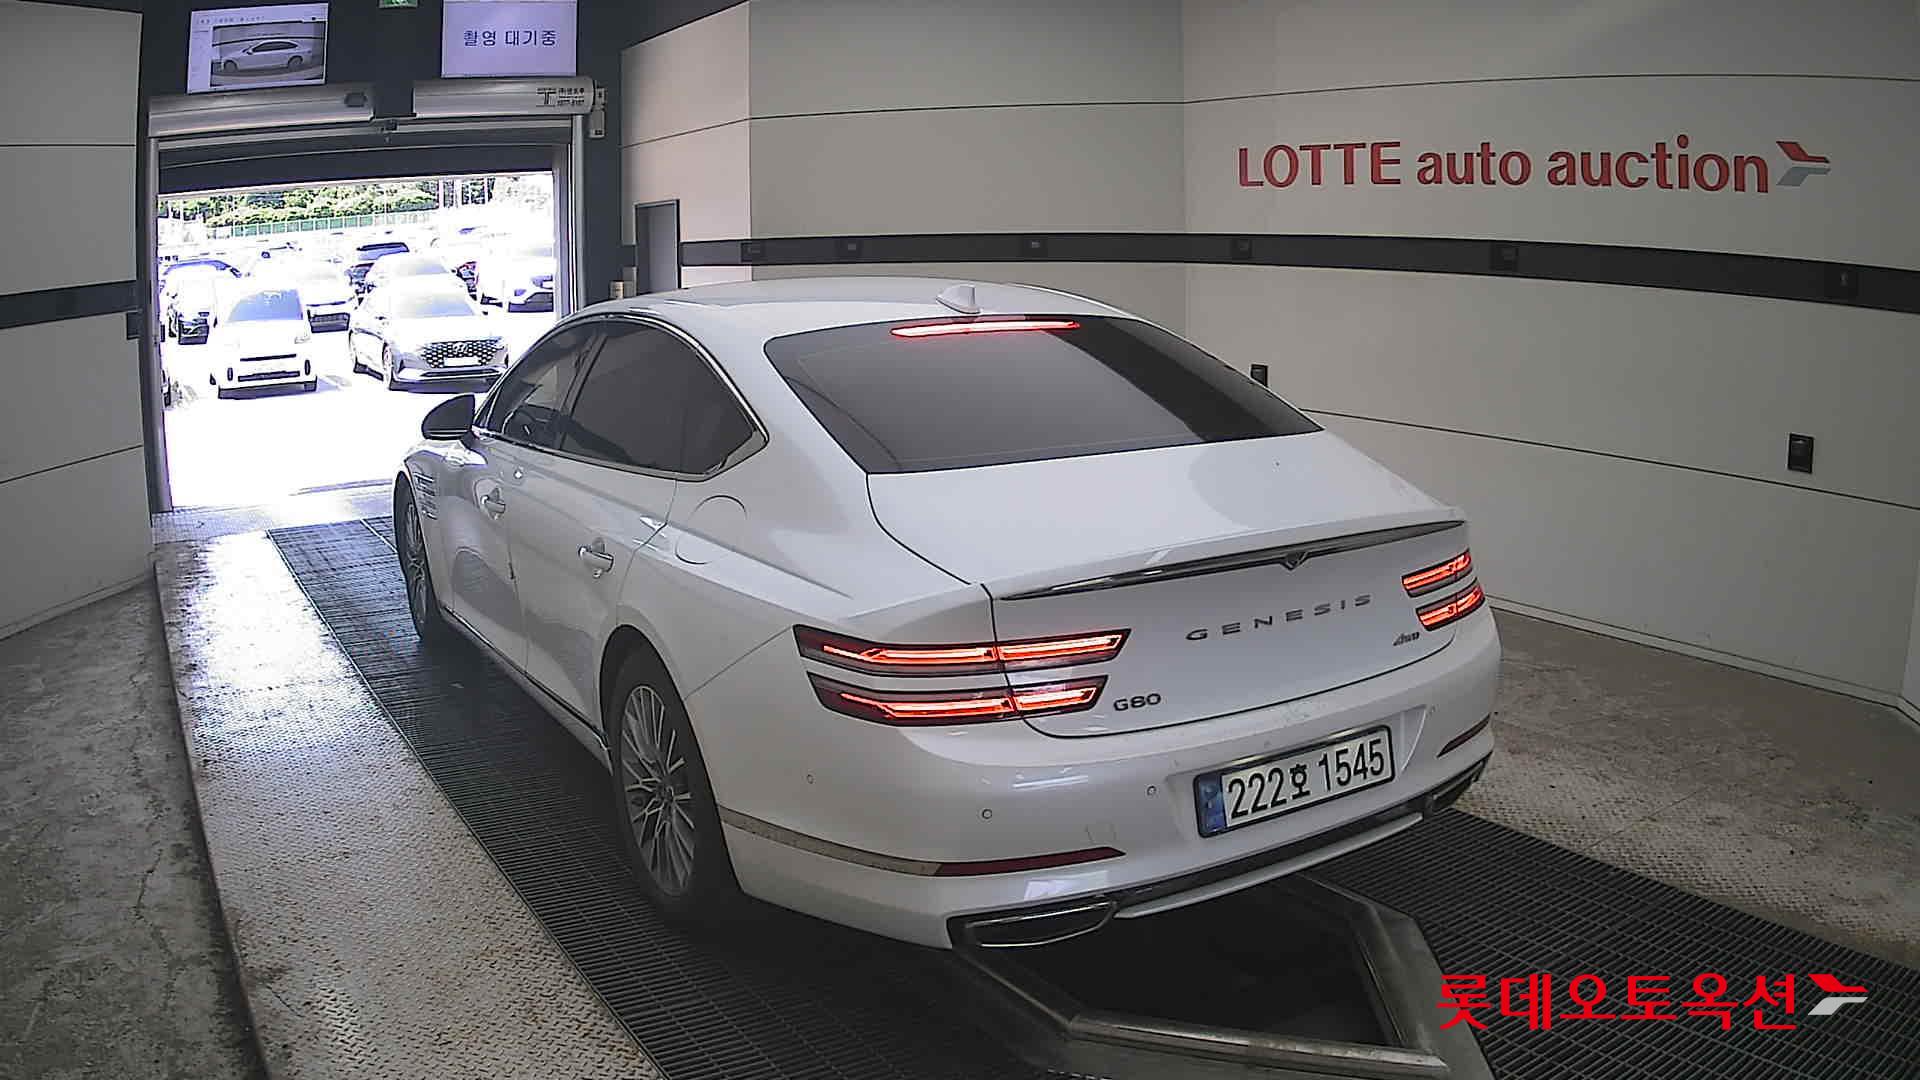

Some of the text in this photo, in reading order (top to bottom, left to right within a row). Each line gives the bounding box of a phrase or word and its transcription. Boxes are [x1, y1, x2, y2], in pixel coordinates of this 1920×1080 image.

[464, 30, 557, 47] 촬영 대기중
[1239, 134, 1769, 194] LOTTE auto auction
[1185, 593, 1372, 642] GENESIS
[1113, 692, 1163, 712] G80
[1226, 738, 1385, 820] 222호 1545
